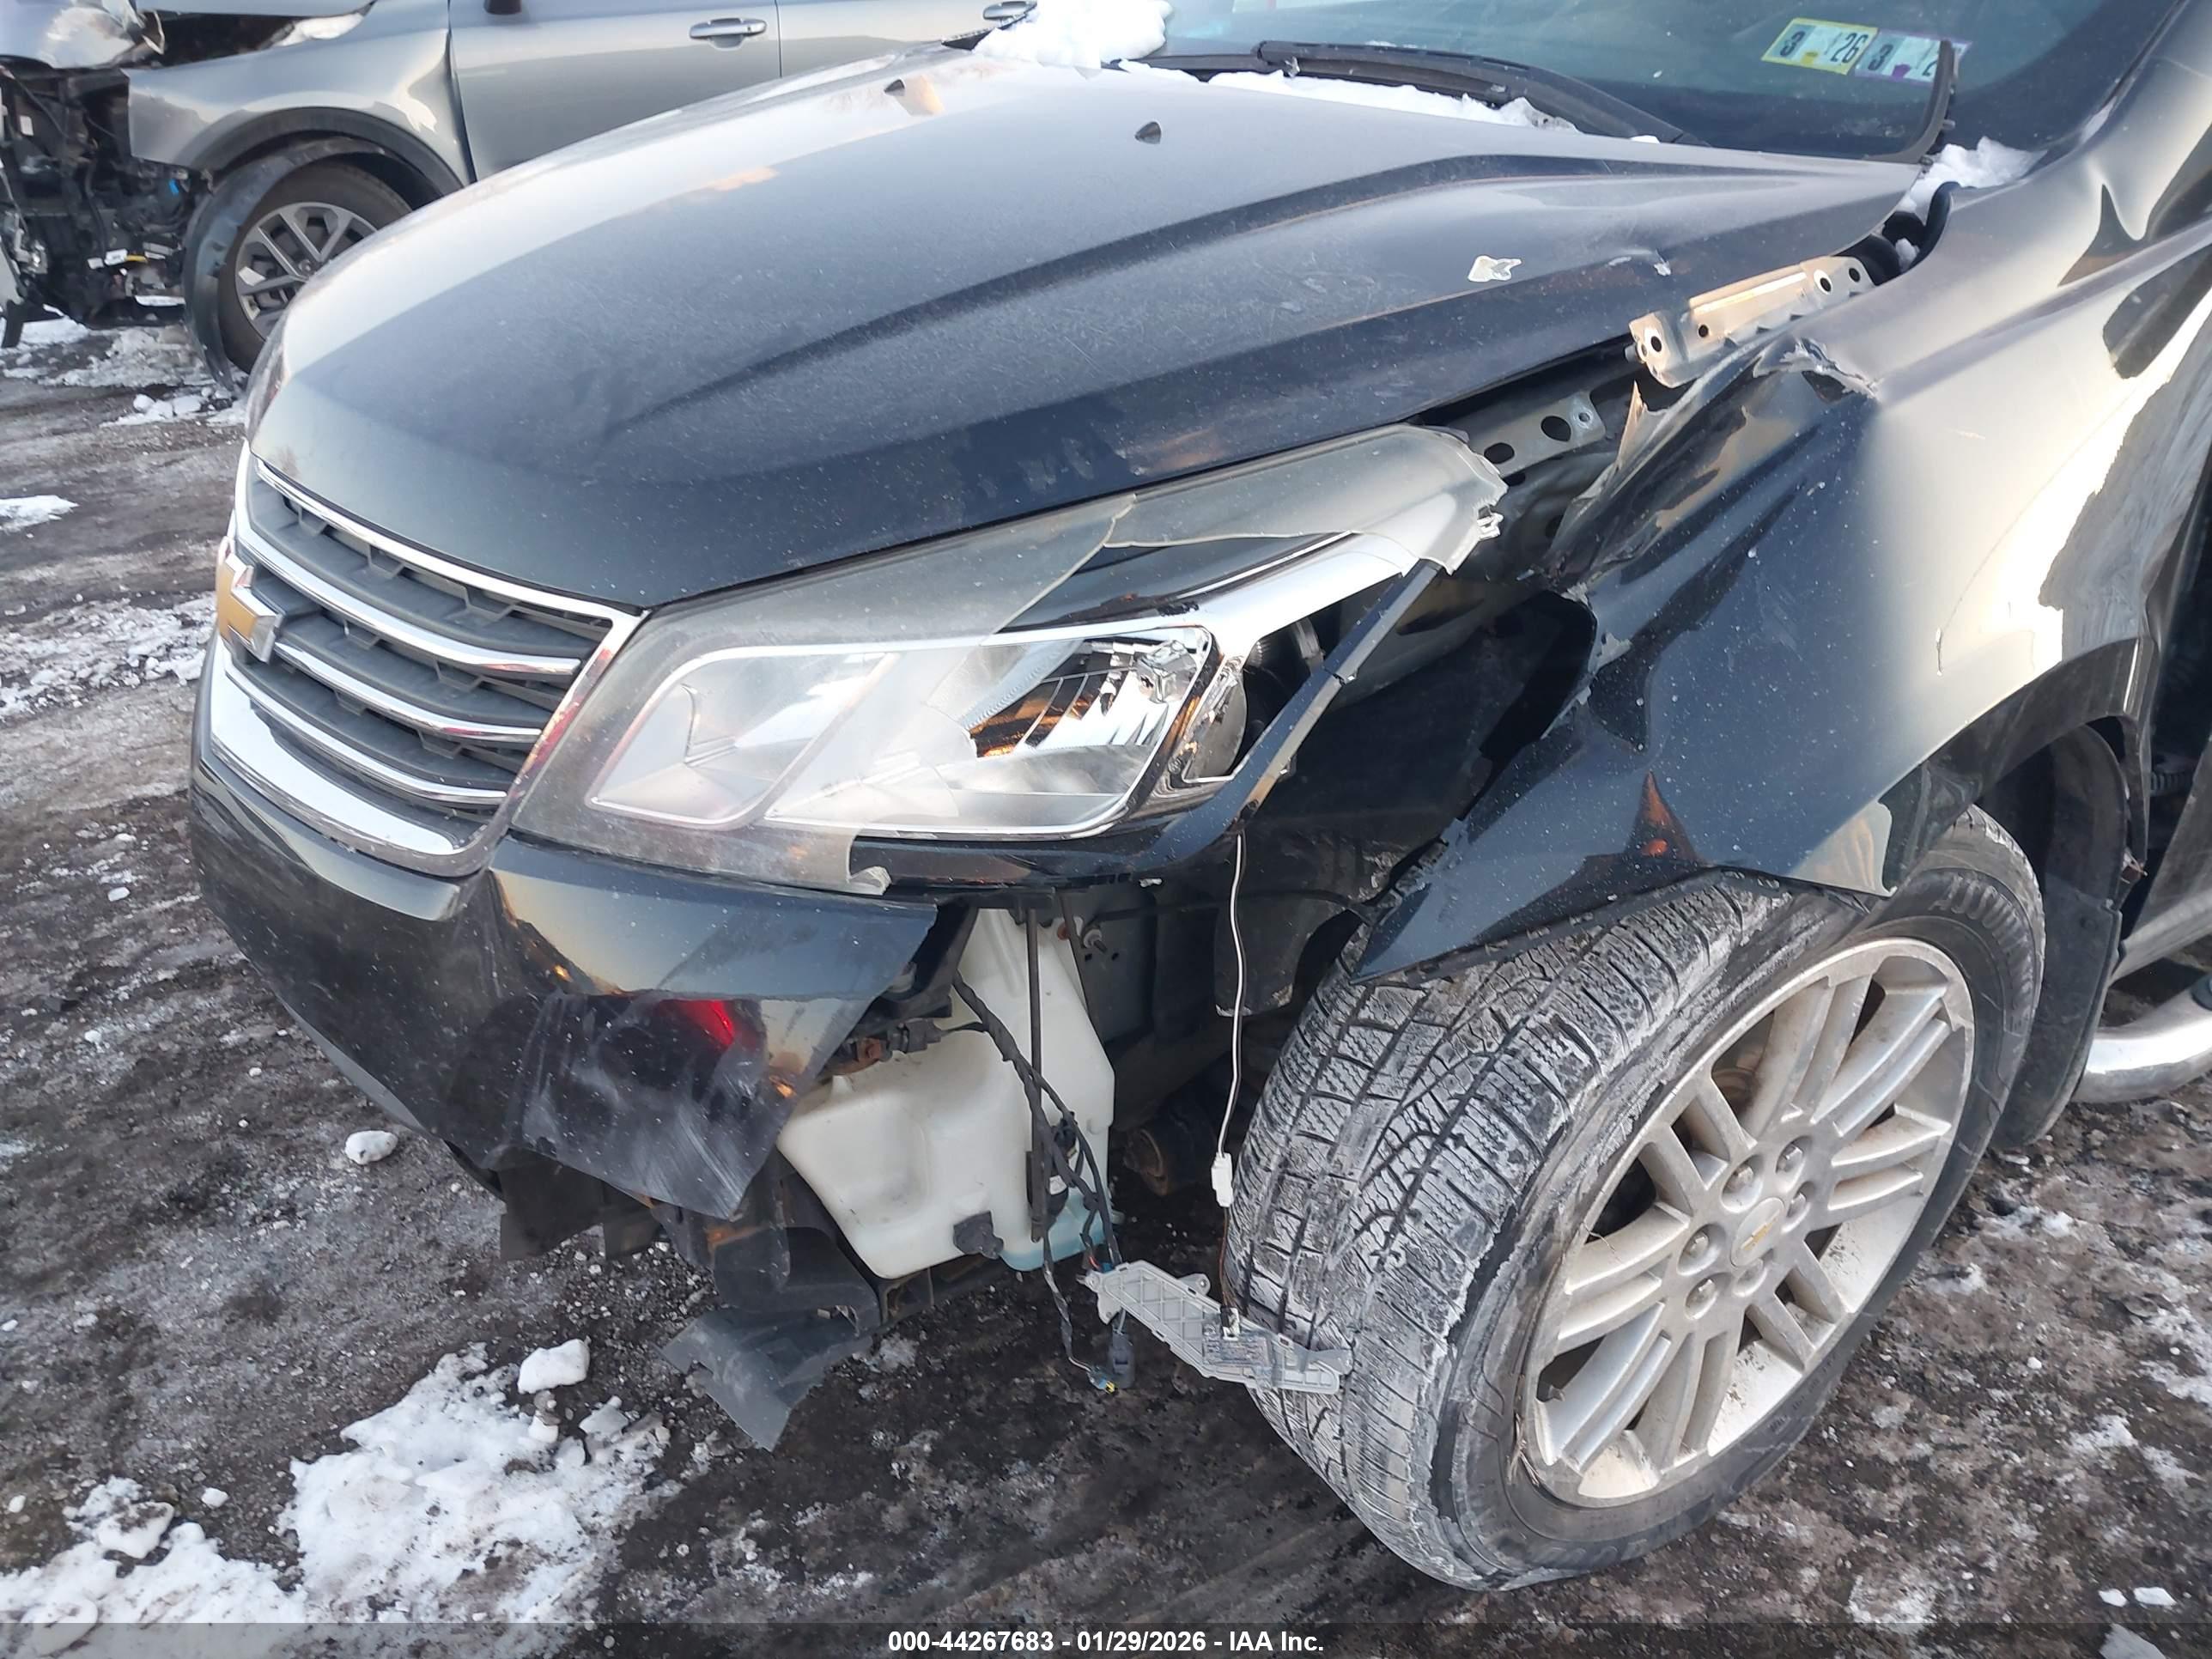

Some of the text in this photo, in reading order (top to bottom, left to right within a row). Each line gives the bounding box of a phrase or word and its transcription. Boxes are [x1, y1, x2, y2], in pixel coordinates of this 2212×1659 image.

[1780, 31, 1806, 57] 3
[1830, 33, 1868, 63] 26
[1868, 44, 1893, 70] 3
